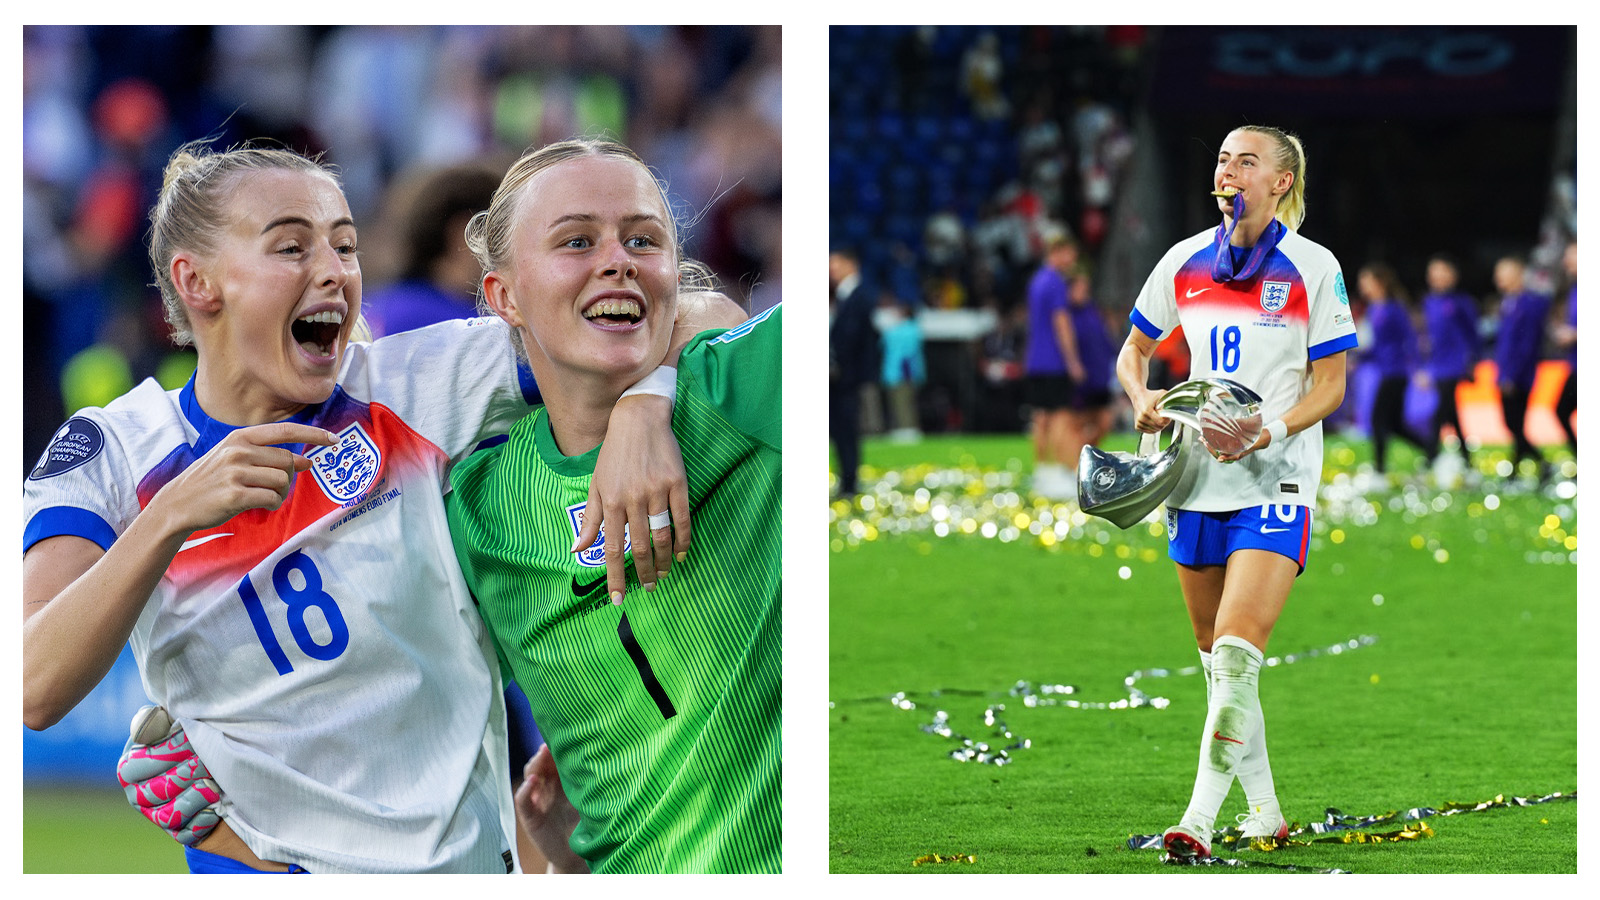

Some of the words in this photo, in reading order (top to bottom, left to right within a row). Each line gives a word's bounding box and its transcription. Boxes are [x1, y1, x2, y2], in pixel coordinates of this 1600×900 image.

[1210, 325, 1241, 373] 18
[51, 447, 88, 458] CHAMPIONS
[51, 453, 74, 462] 2022
[57, 441, 91, 452] EUROPEAN
[343, 507, 367, 524] WOMENS
[367, 496, 383, 511] EURO
[381, 487, 401, 504] FINAL
[237, 547, 350, 676] 18
[616, 610, 677, 720] 1
